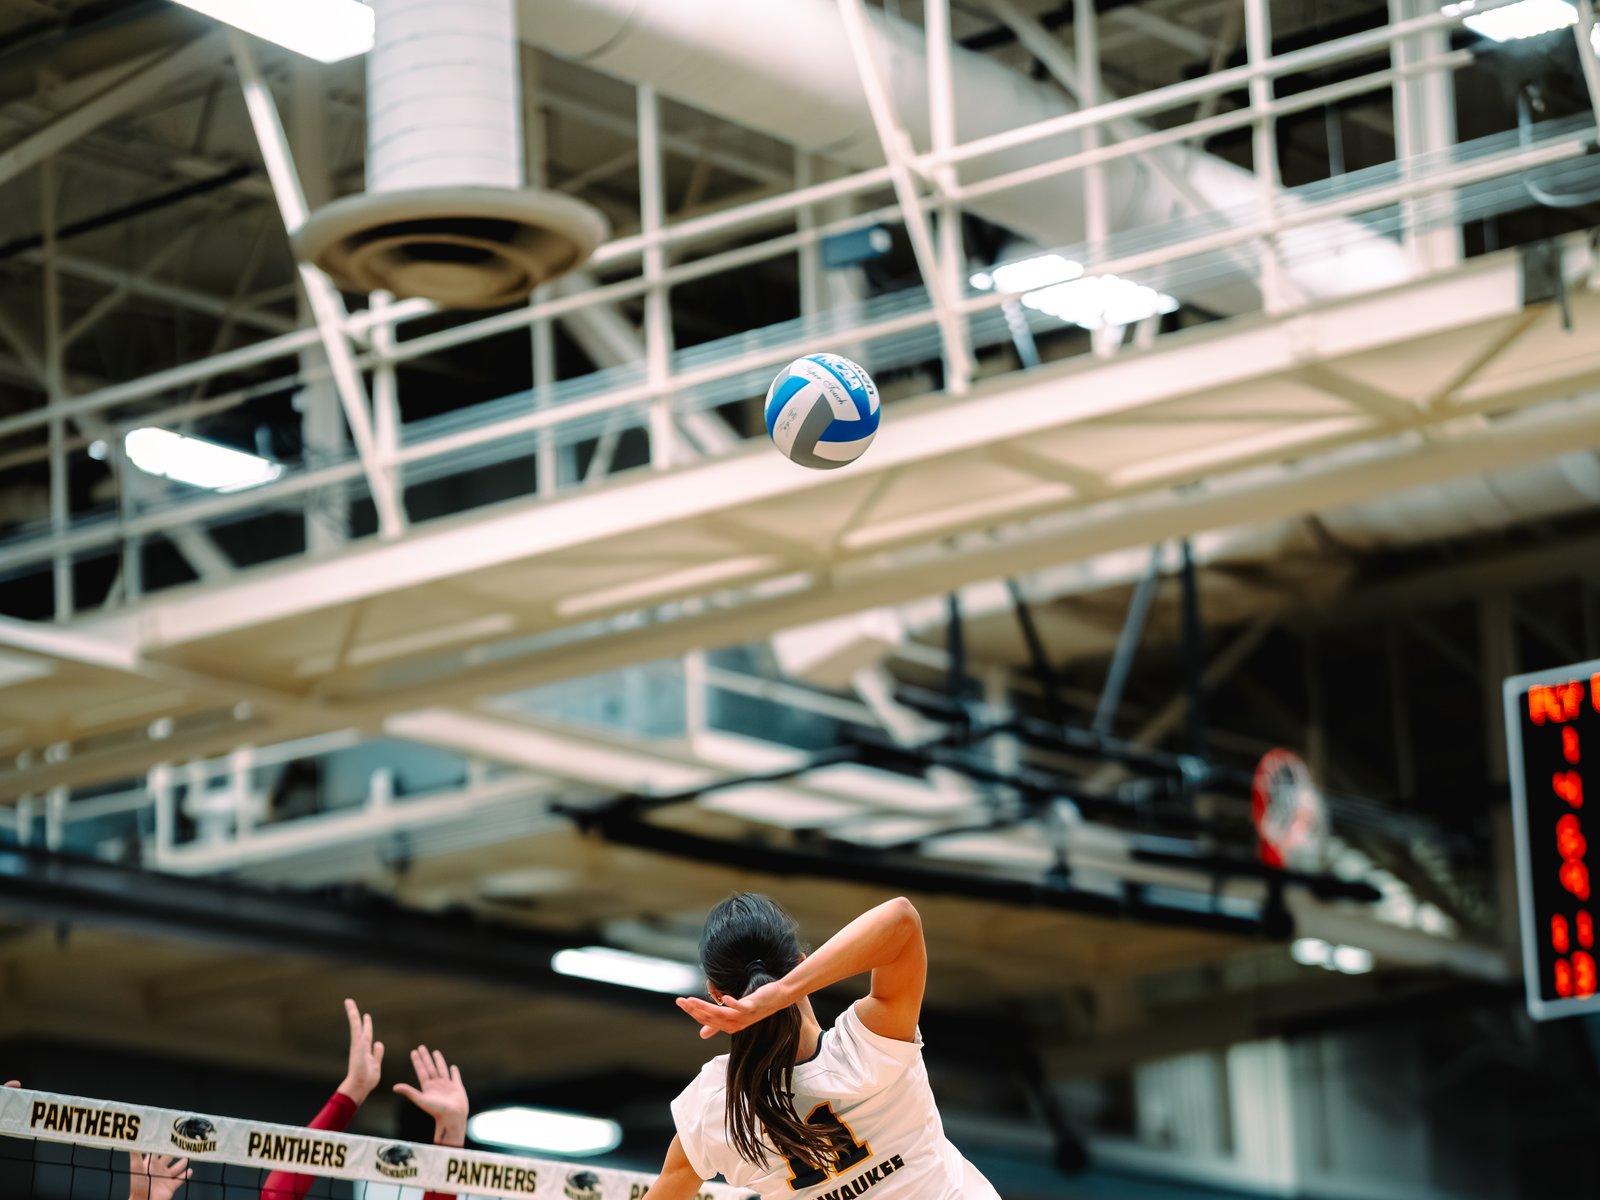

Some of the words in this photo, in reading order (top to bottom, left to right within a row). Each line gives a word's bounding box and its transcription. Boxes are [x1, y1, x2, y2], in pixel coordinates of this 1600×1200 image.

[823, 380, 847, 405] Touch
[30, 1101, 141, 1141] PANTHERS
[170, 1133, 216, 1152] MILWAUKEE
[247, 1131, 348, 1168] PANTHERS
[445, 1158, 537, 1194] PANTHERS
